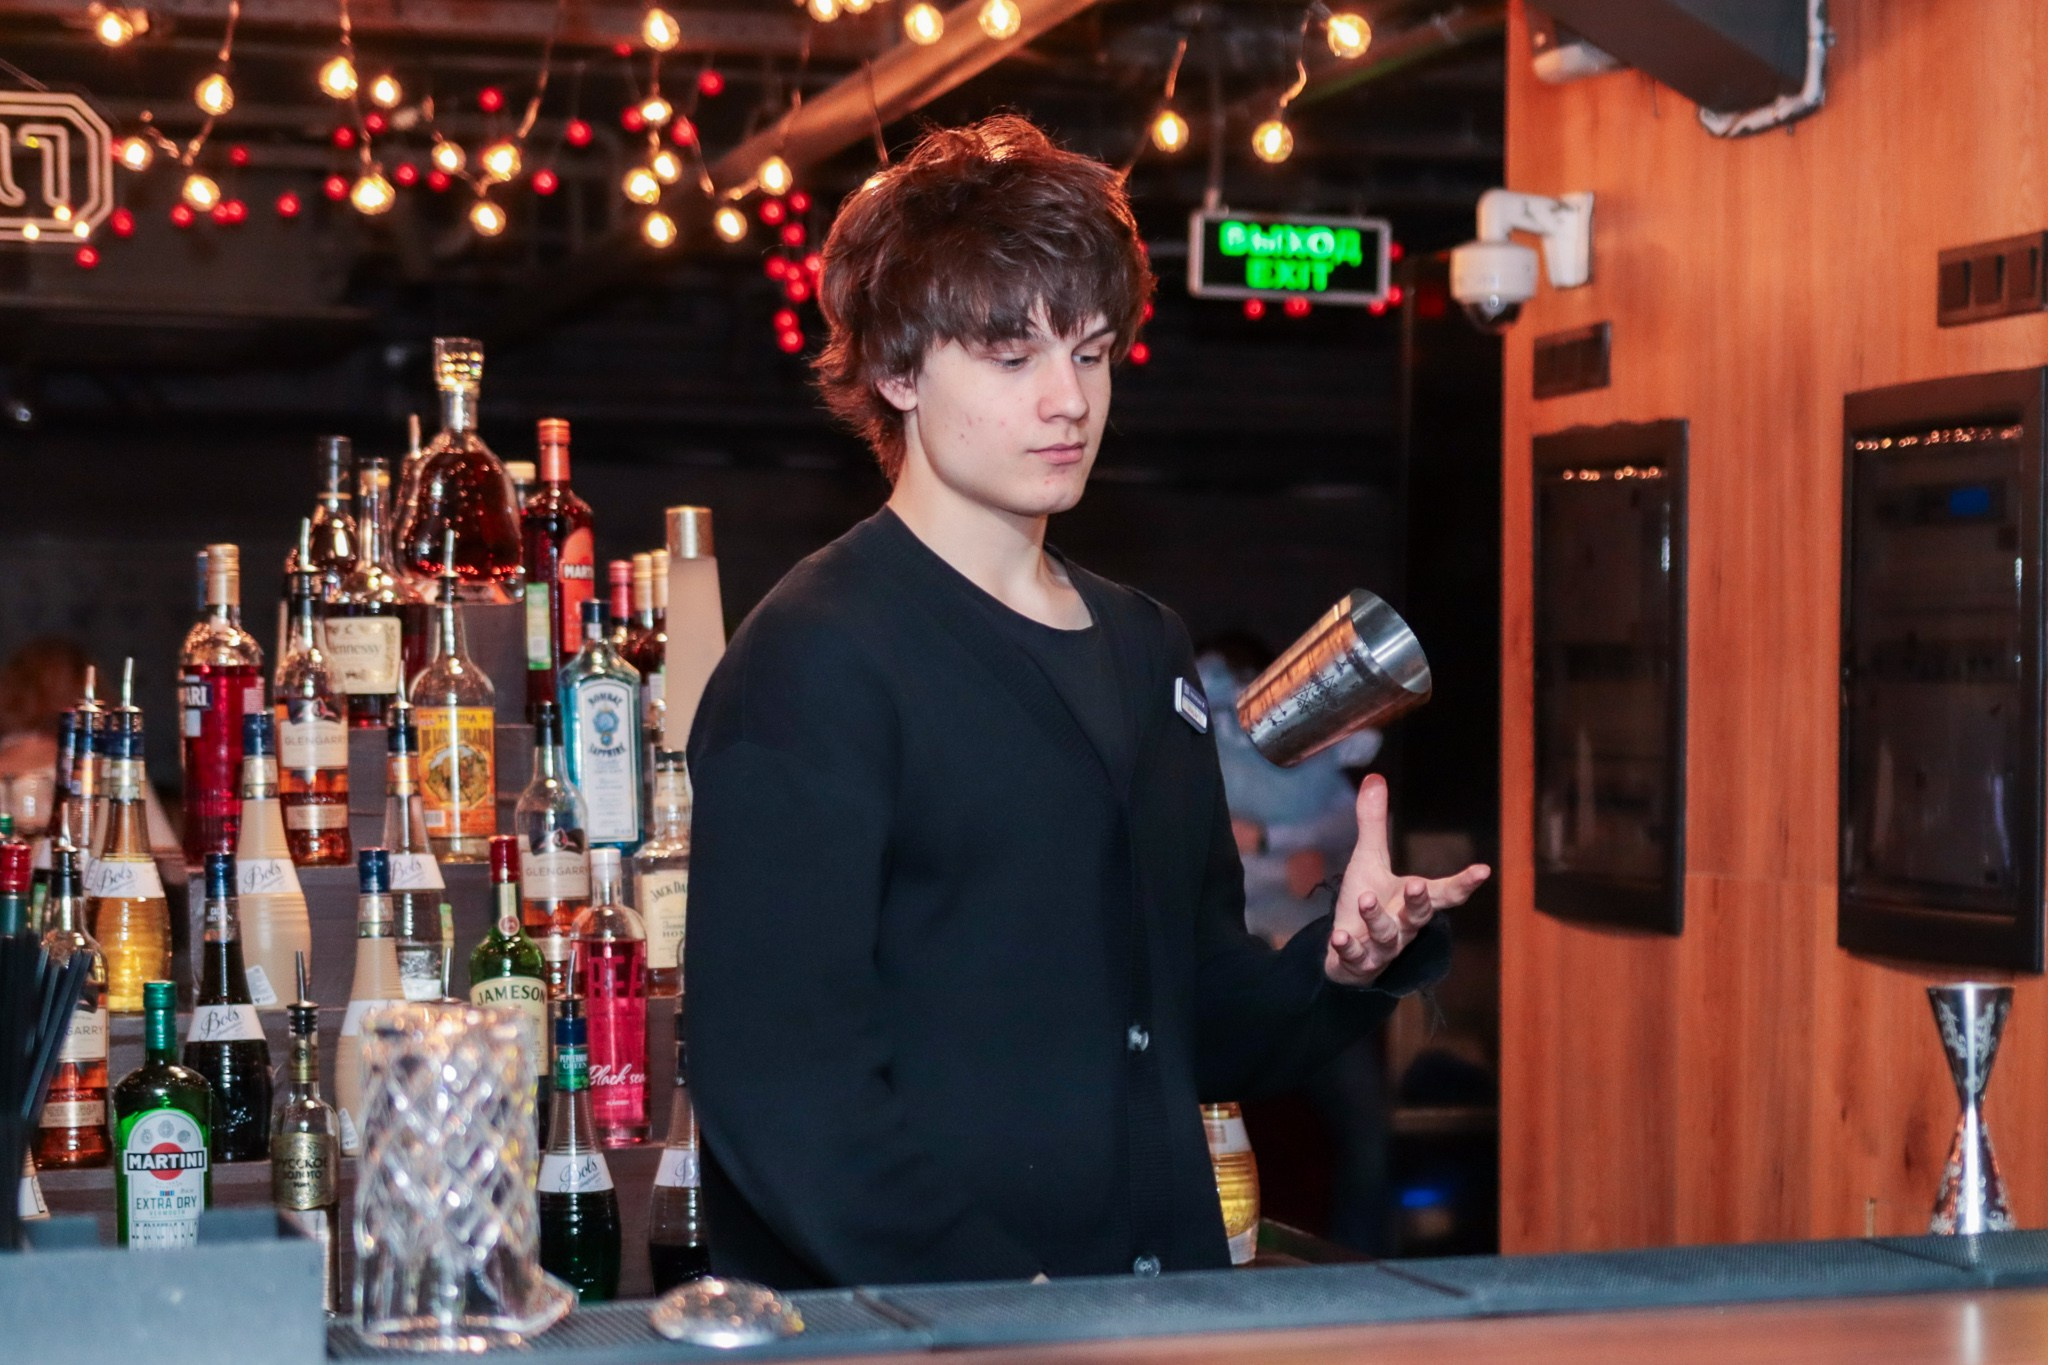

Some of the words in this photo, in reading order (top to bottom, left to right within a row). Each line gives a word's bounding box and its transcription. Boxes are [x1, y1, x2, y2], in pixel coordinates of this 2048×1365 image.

[1246, 256, 1333, 292] EXIT
[588, 692, 624, 708] BOMBAY
[589, 742, 626, 757] SAPPHIRE
[243, 860, 282, 894] Bols
[650, 885, 673, 903] JACK
[673, 881, 688, 894] DA
[477, 984, 546, 1007] JAMESON
[199, 1004, 241, 1041] Bols
[589, 1062, 632, 1086] Black
[128, 1151, 204, 1170] MARTINI
[558, 1153, 599, 1193] Bols
[136, 1196, 173, 1210] EXTRA
[176, 1195, 197, 1209] DRY
